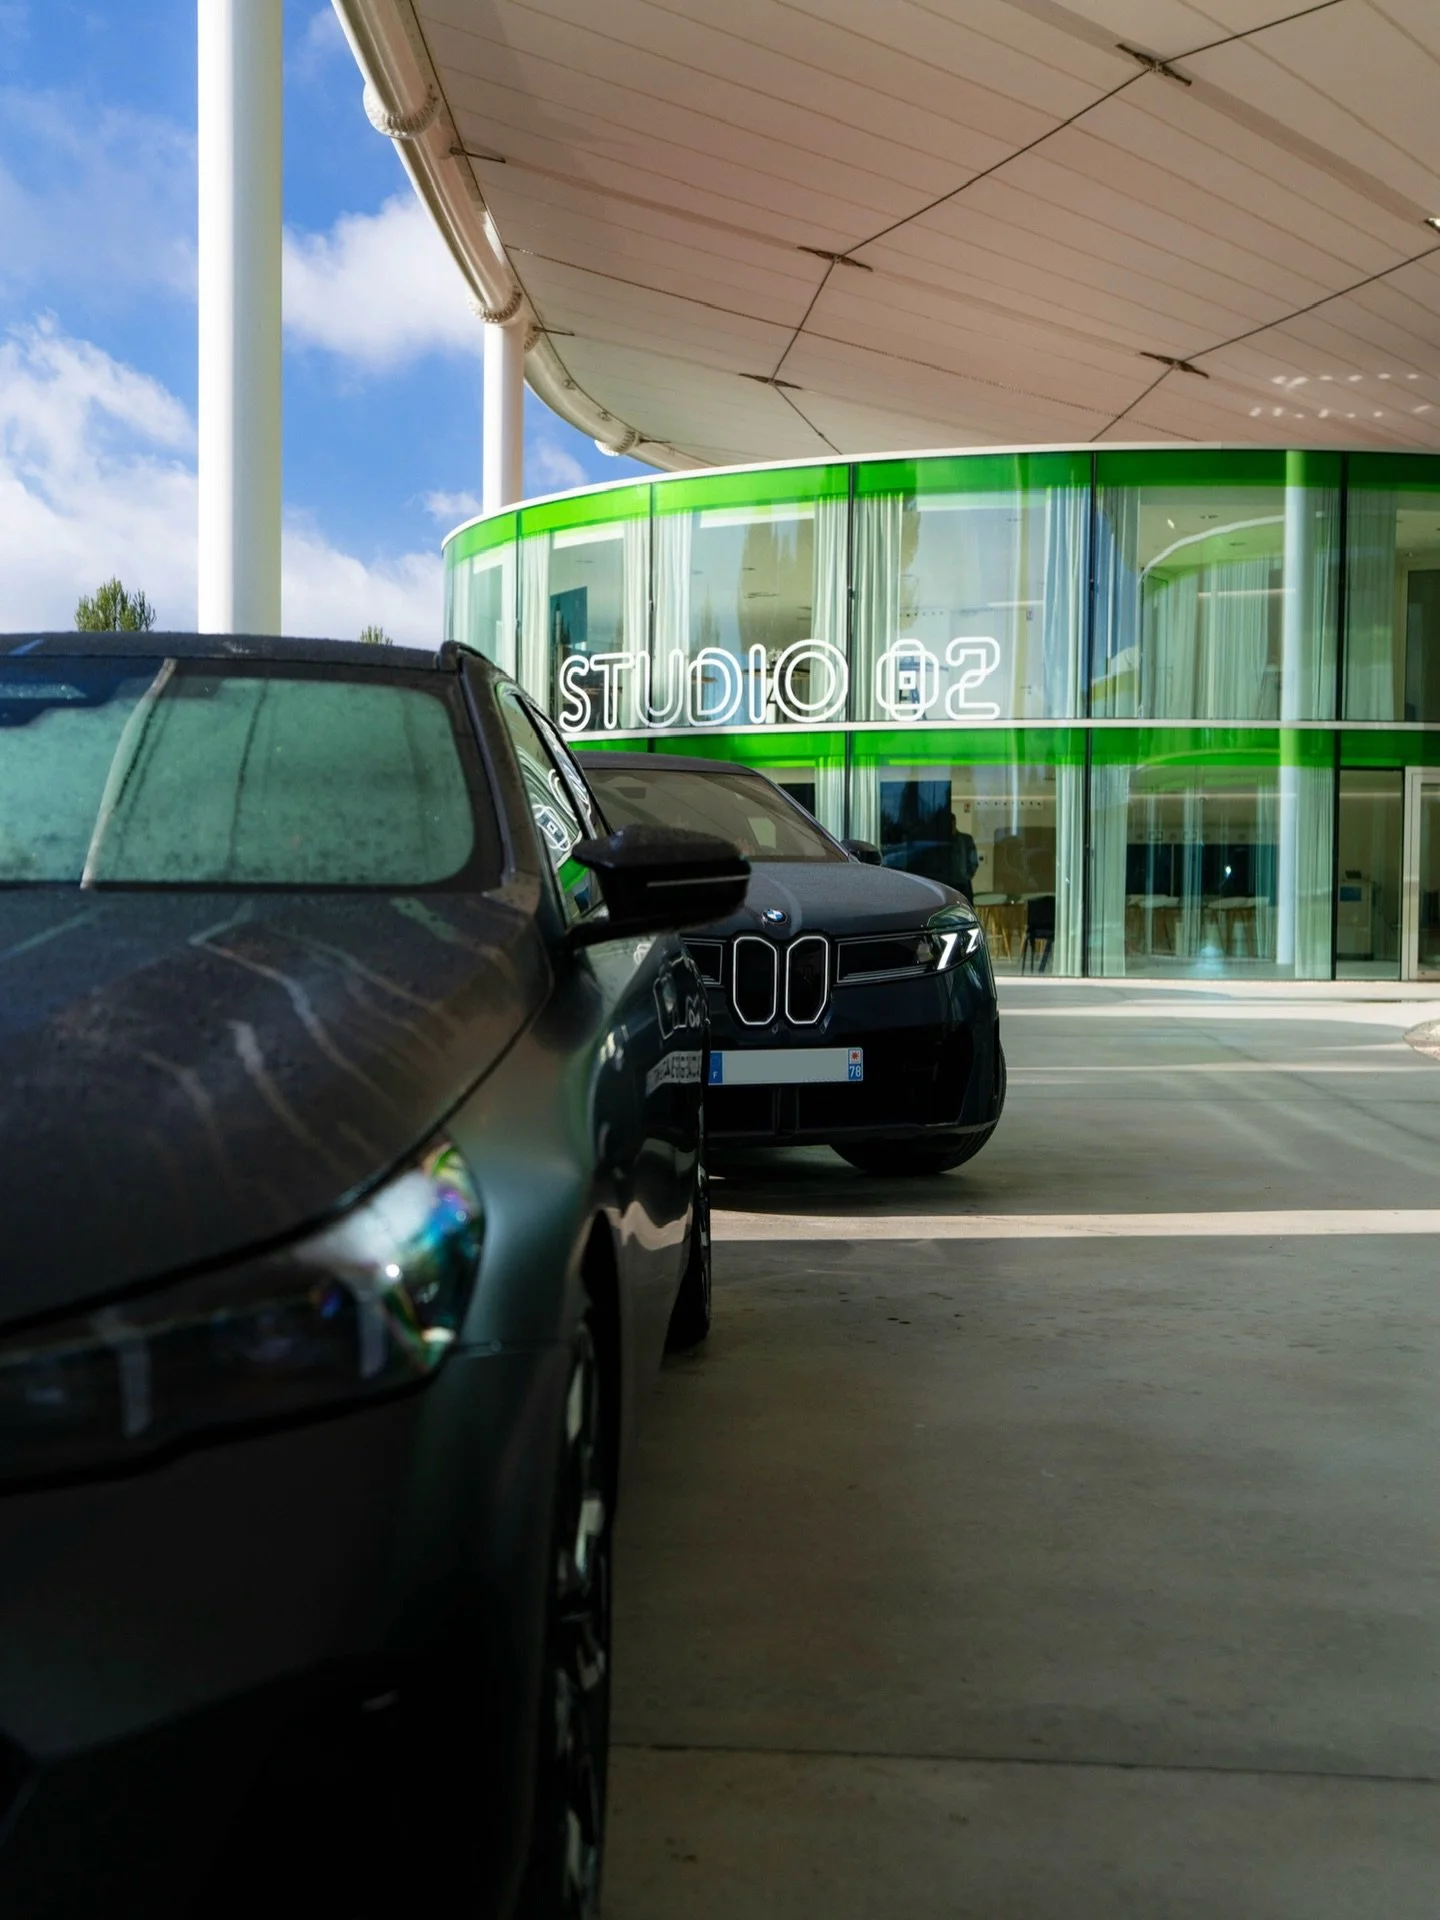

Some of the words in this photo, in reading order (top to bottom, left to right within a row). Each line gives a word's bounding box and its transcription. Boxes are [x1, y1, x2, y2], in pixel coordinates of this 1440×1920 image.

[559, 639, 848, 732] STUDIO
[876, 637, 1001, 721] 02
[849, 1065, 861, 1078] 78
